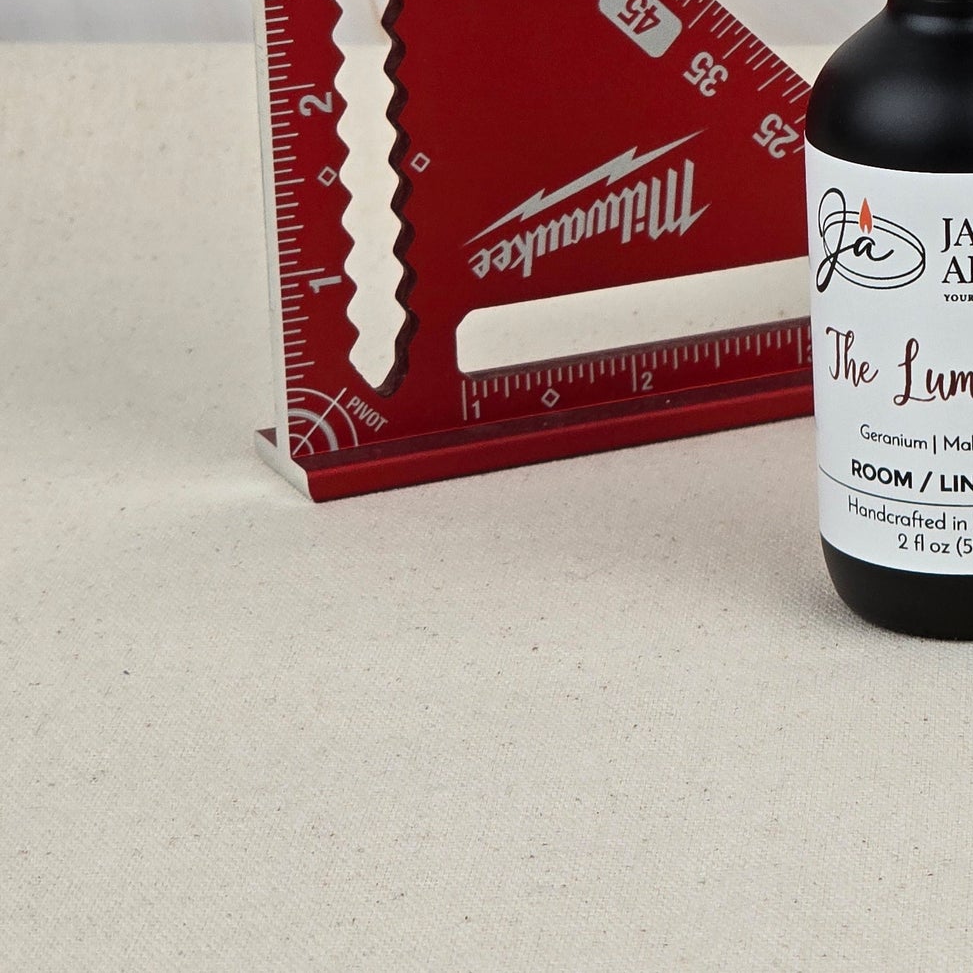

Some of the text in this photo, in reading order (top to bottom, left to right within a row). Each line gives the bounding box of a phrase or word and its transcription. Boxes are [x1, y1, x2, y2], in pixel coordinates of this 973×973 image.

[683, 51, 729, 98] 35
[300, 92, 333, 116] 2
[752, 112, 799, 159] 25
[468, 158, 712, 278] Milwaukee
[309, 276, 342, 294] 1
[826, 326, 879, 387] The
[640, 371, 653, 391] 2
[345, 395, 389, 433] PIVOT
[471, 400, 481, 419] 1
[860, 423, 928, 451] Geranium
[851, 459, 913, 489] ROOM
[848, 495, 946, 530] Handcrafted
[953, 516, 967, 531] in
[898, 534, 908, 550] 2
[914, 533, 925, 551] fl
[930, 542, 950, 554] oz
